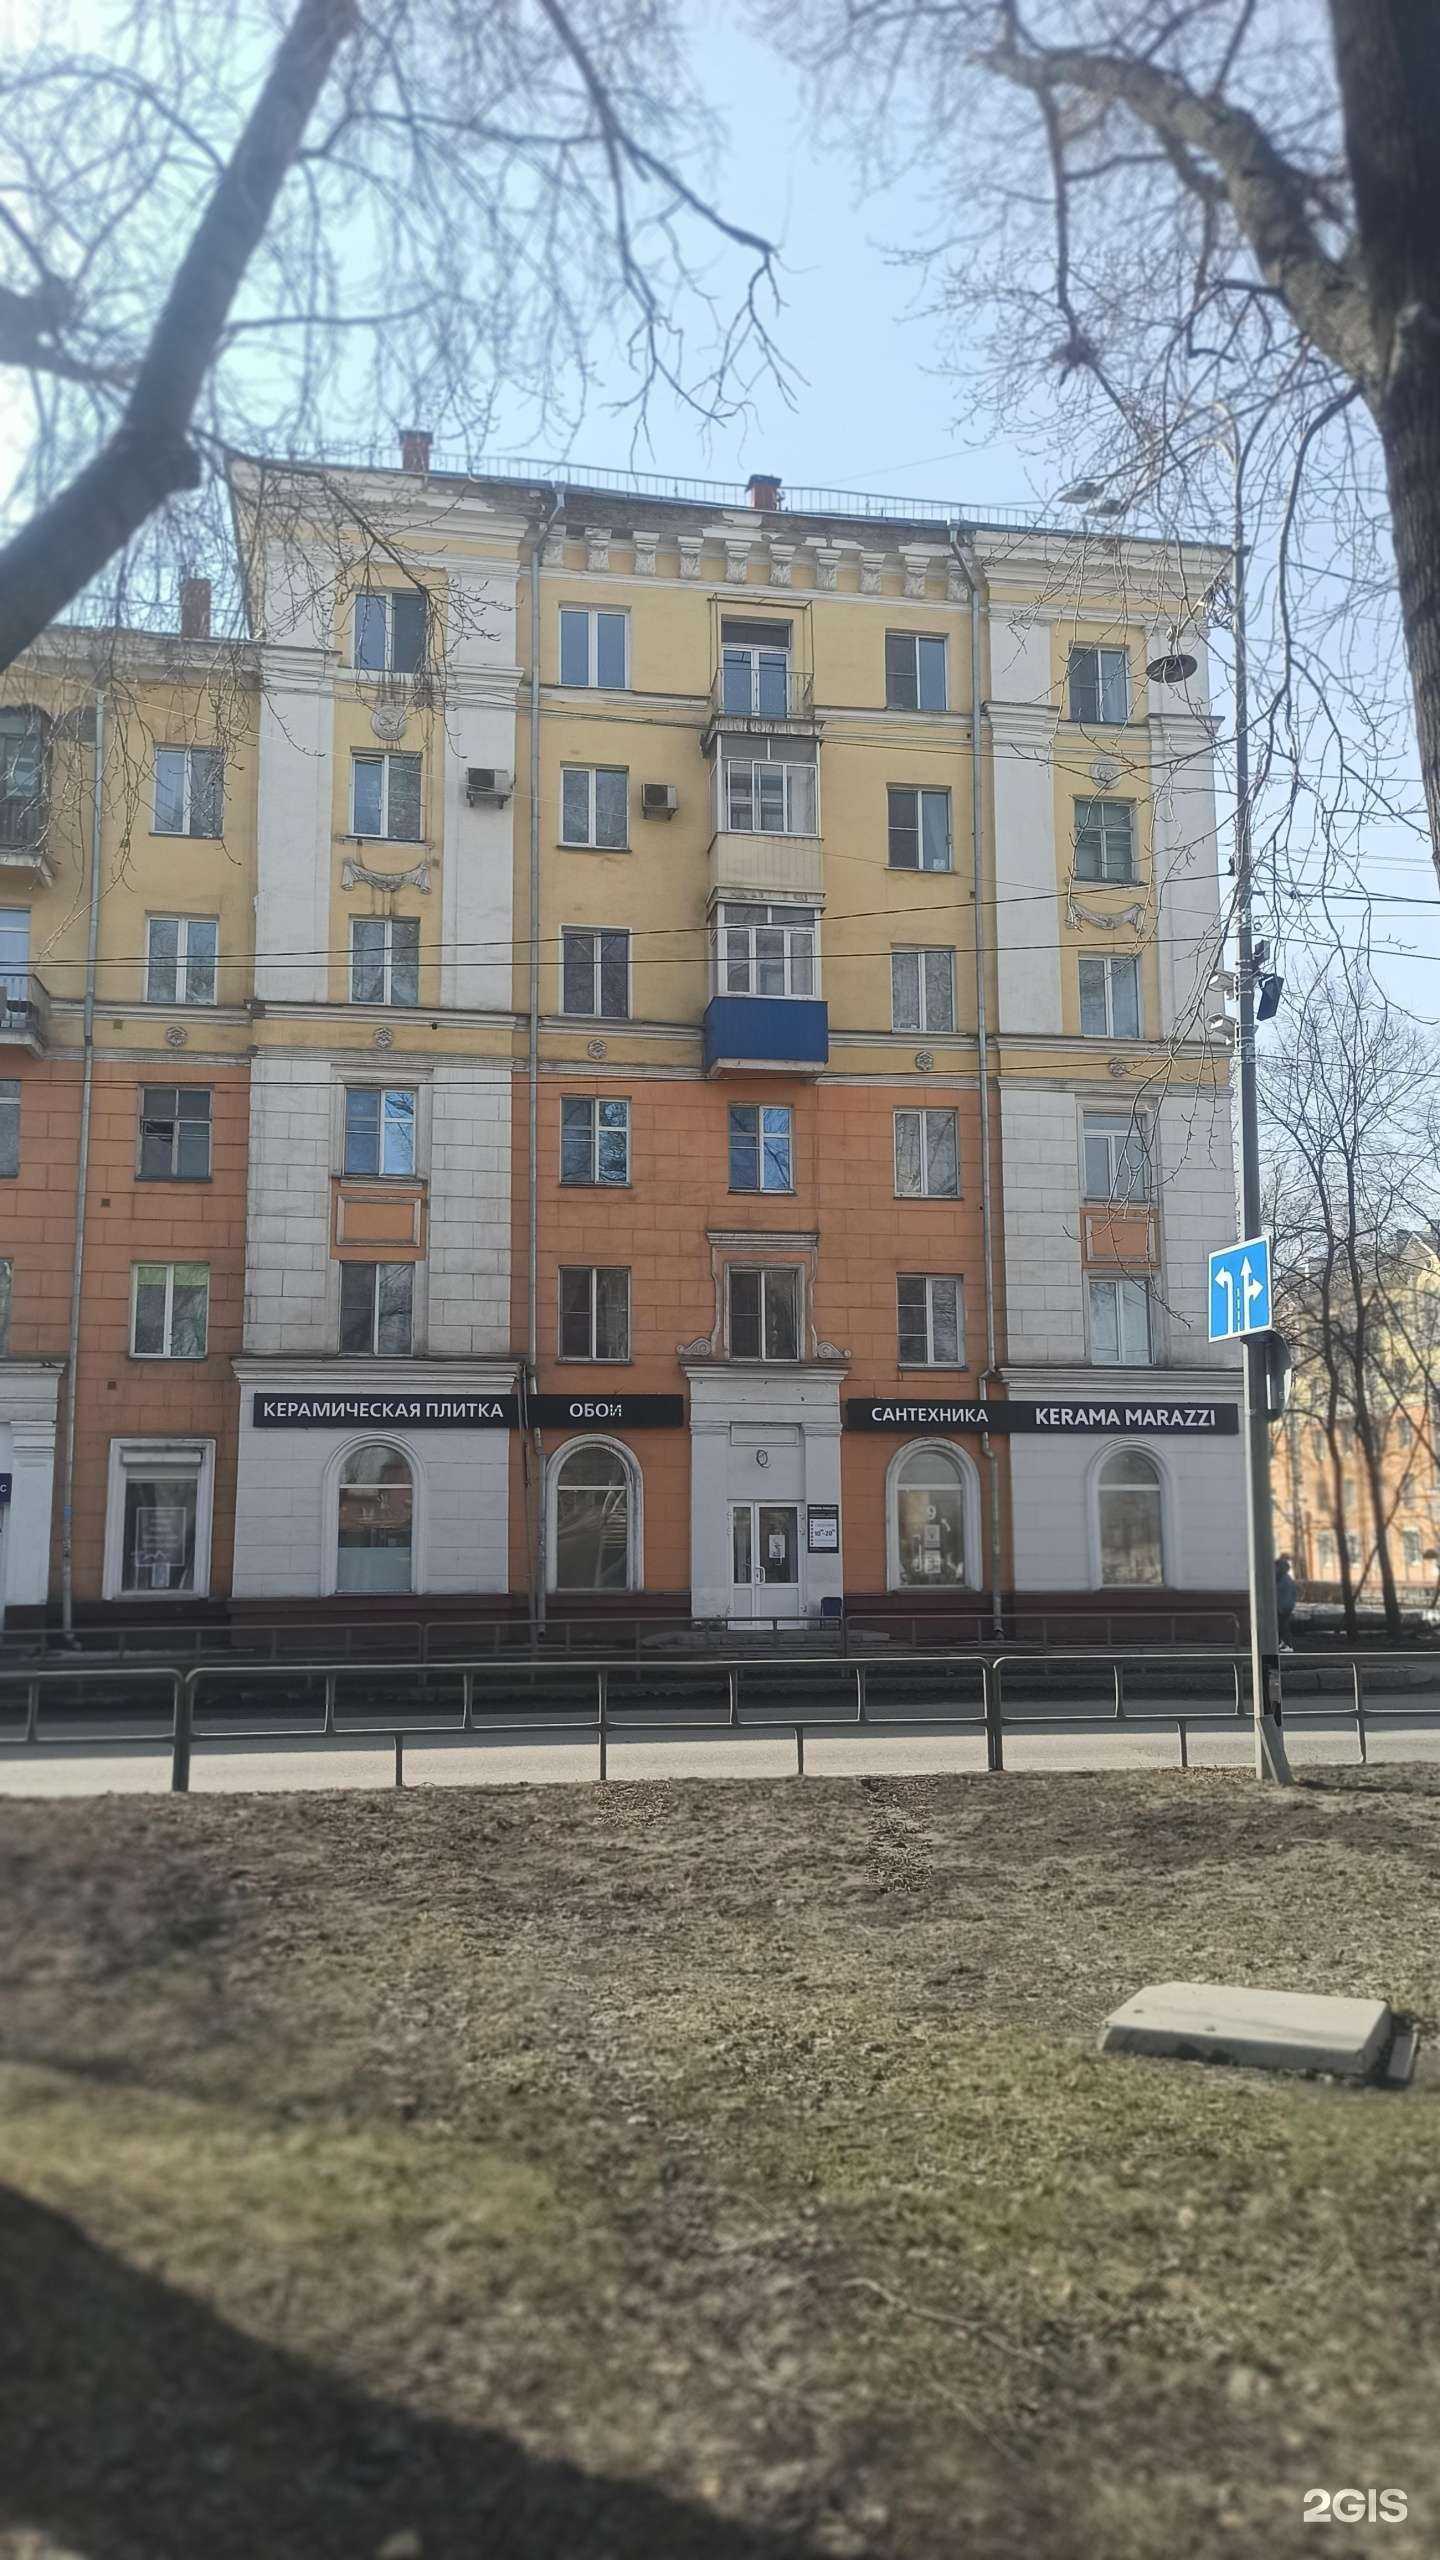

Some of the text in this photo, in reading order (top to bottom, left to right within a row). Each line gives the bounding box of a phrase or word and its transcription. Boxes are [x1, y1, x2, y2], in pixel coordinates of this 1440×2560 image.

[263, 1402, 504, 1418] КЕРАМИЧЕСКАЯ ПЛИТКА
[569, 1402, 622, 1418] ОБОИ
[871, 1407, 989, 1422] САНТЕХНИКА
[1035, 1407, 1216, 1427] KERAMA MARAZZI
